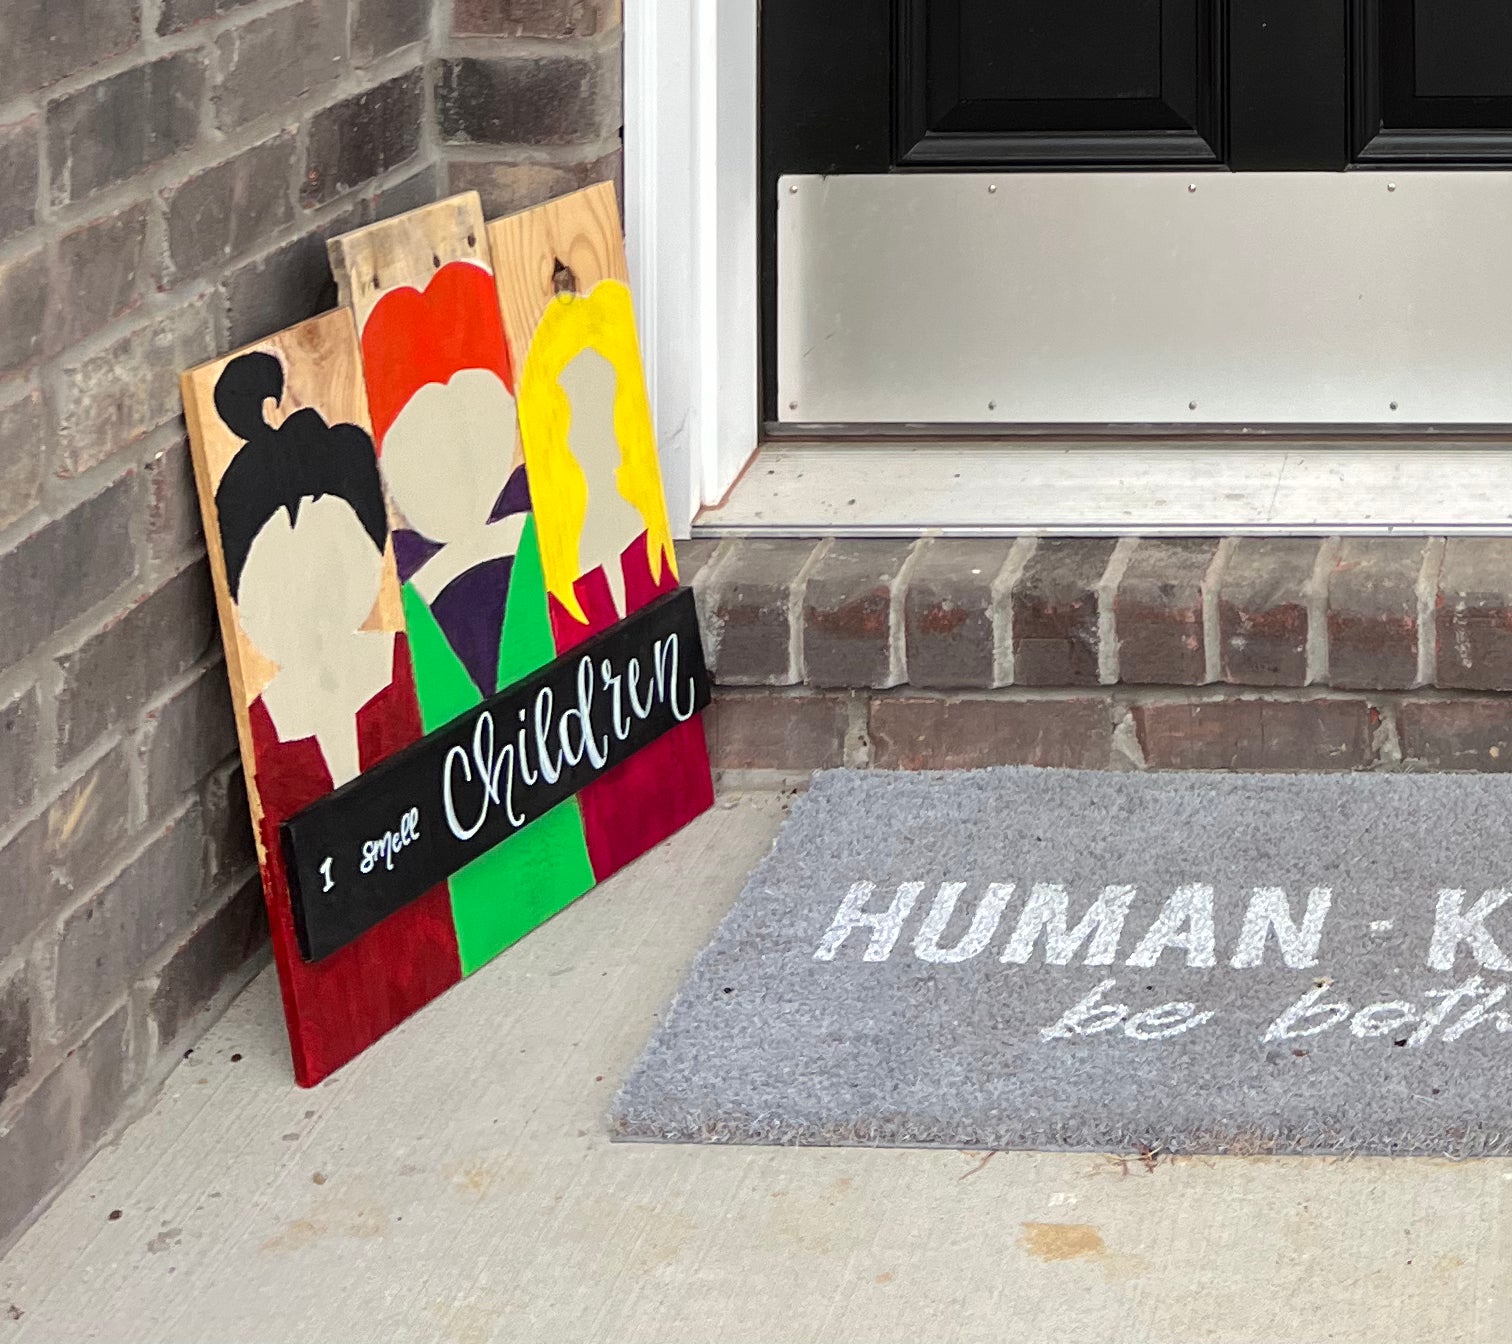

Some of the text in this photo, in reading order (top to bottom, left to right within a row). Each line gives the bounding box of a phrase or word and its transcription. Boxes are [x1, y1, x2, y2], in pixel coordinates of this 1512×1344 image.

[359, 807, 420, 874] smell
[442, 632, 695, 841] Children
[812, 879, 1333, 970] HUMAN
[1040, 978, 1215, 1042] be
